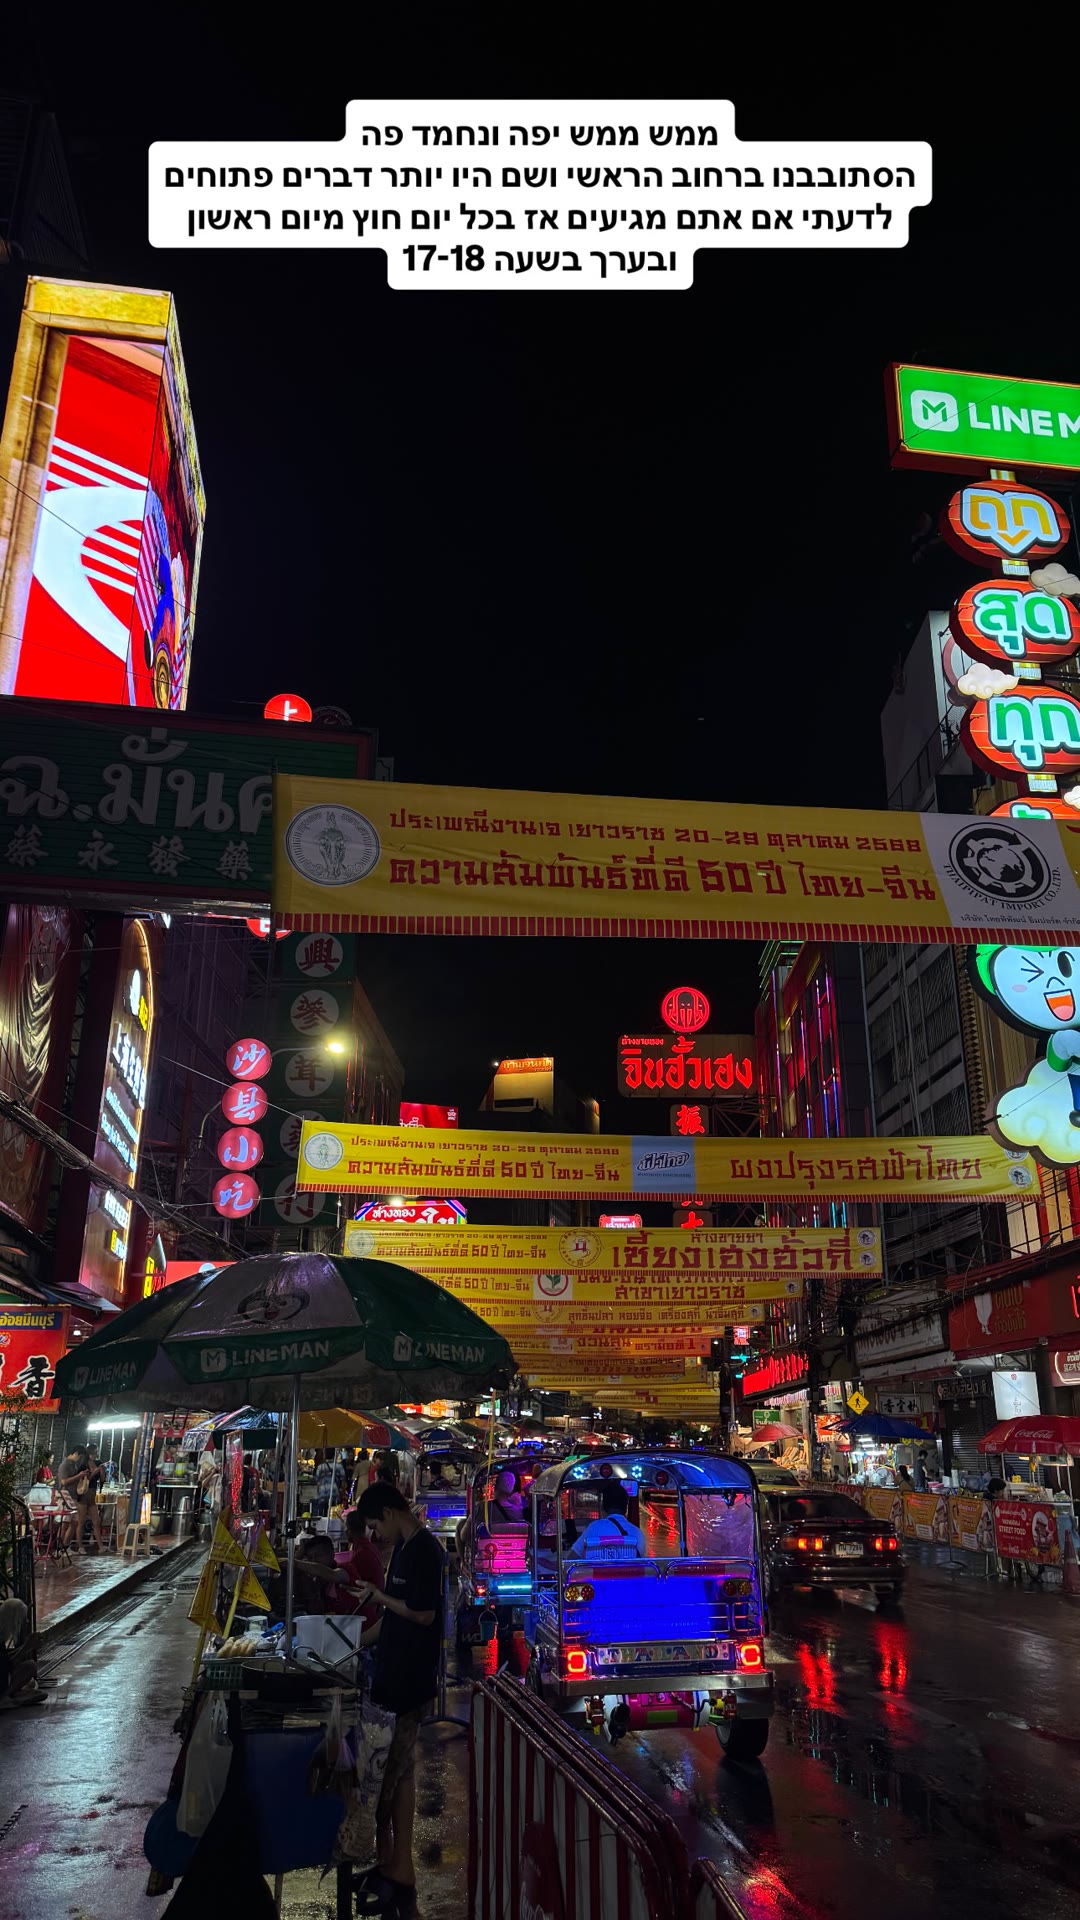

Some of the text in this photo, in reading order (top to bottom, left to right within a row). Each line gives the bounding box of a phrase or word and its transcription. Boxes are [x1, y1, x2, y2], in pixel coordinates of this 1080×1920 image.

[968, 402, 1054, 437] LINE
[976, 591, 1070, 654] สุด
[991, 700, 1080, 763] ทุก
[568, 823, 666, 842] เยาวราช
[674, 828, 759, 846] 20-29
[766, 832, 850, 853] ตุลาคม
[855, 836, 922, 853] 2568
[389, 846, 691, 892] ความสัมพันธ์ที่ดี
[788, 860, 936, 901] ไทย-จีน
[943, 863, 999, 907] THAIPIPAT
[1000, 899, 1046, 911] IMPORT
[620, 1035, 754, 1090] จินฮั้วเฮง
[347, 1153, 496, 1178] ความสัมพันธ์ที่ดี
[547, 1160, 621, 1181] ไทย-จีน
[730, 1144, 982, 1190] ผงปรุงรสฟ้าไทย
[614, 1284, 746, 1300] สาขาเยาวราช
